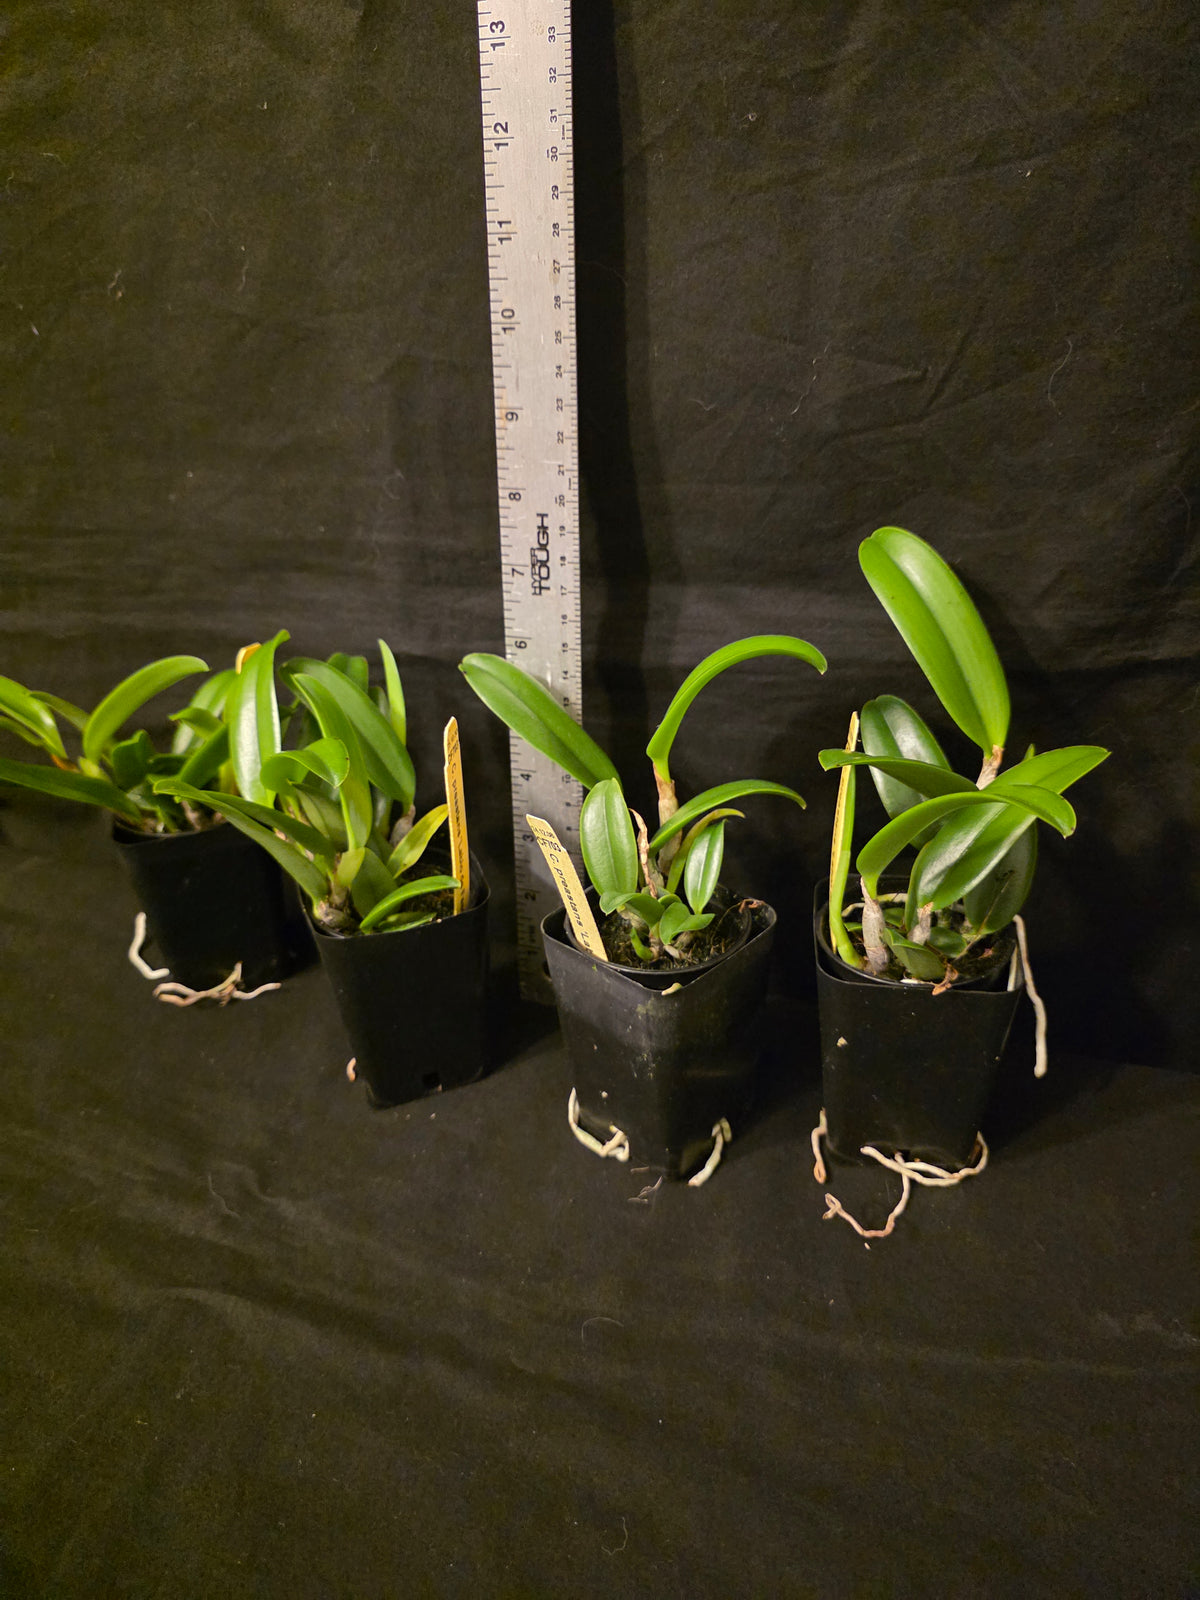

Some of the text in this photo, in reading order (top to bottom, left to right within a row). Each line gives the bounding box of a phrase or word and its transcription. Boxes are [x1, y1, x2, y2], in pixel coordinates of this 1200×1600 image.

[547, 26, 556, 43] 33
[548, 66, 557, 84] 32
[549, 108, 558, 123] 31
[550, 146, 559, 162] 30
[551, 185, 559, 200] 29
[552, 222, 560, 238] 28
[553, 259, 561, 274] 27
[554, 330, 562, 345] 25
[555, 365, 563, 378] 24
[505, 411, 519, 422] 9
[557, 431, 565, 444] 22
[557, 464, 565, 476] 21
[508, 492, 522, 502] 8
[558, 494, 566, 507] 20
[559, 525, 567, 537] 19
[536, 513, 550, 595] TOUGH
[560, 555, 567, 567] 18
[511, 567, 525, 578] 7
[560, 585, 568, 595] 17
[561, 614, 568, 625] 16
[514, 640, 528, 650] 6
[562, 642, 569, 653] 15
[562, 670, 569, 680] 14
[520, 773, 532, 782] 4
[564, 774, 572, 784] 10
[522, 834, 535, 843] 3
